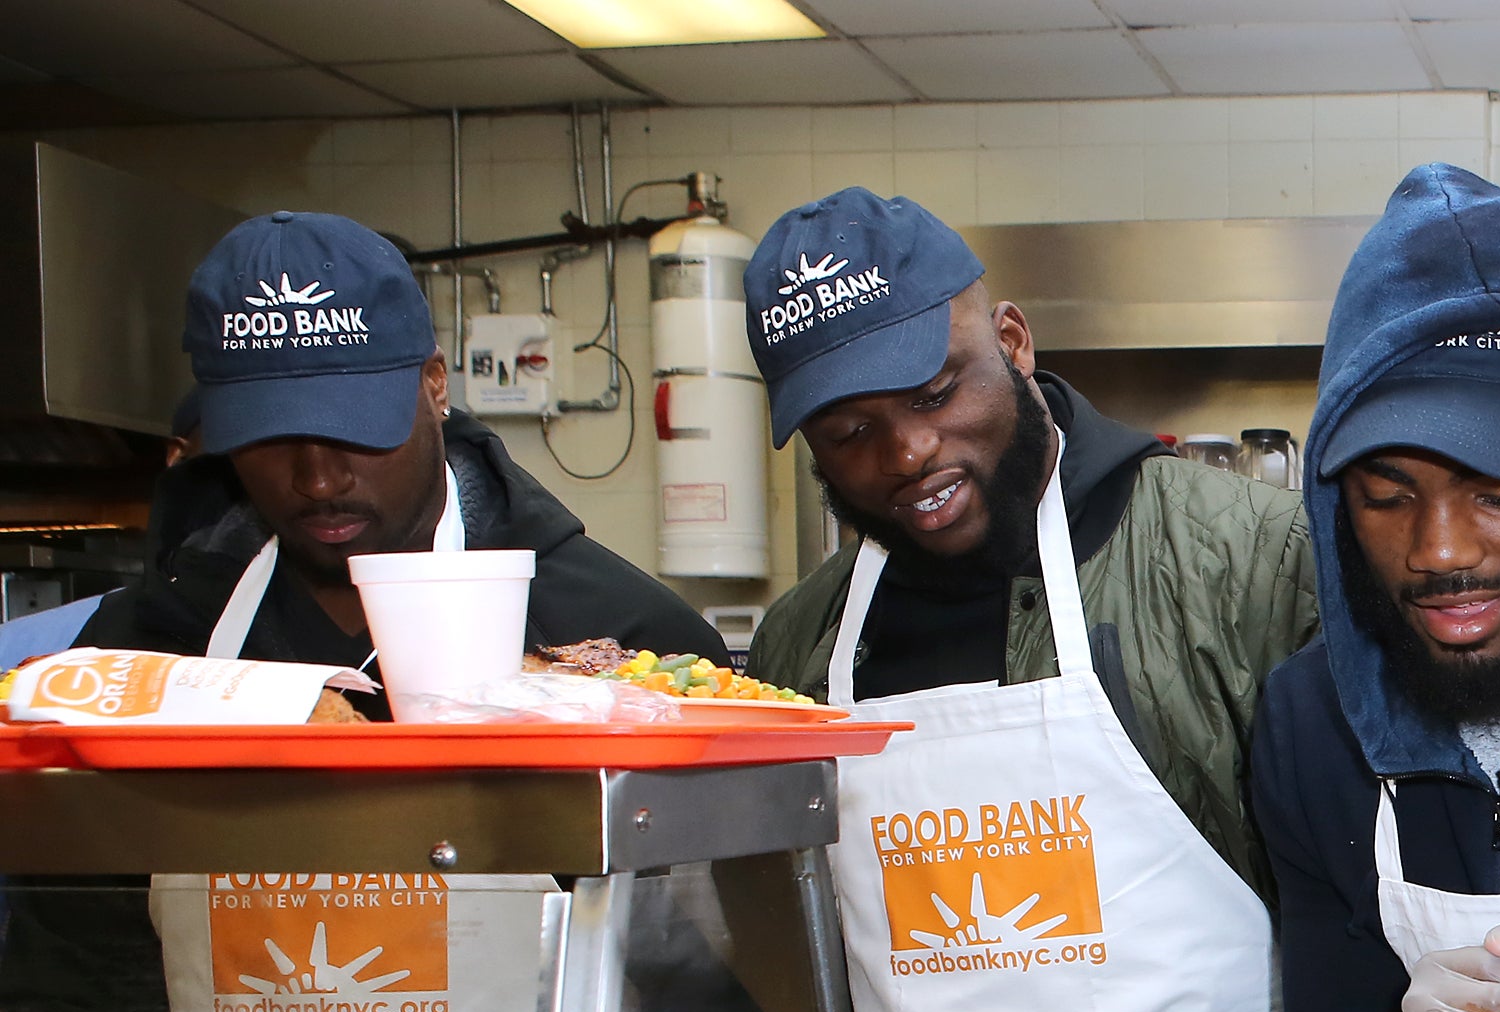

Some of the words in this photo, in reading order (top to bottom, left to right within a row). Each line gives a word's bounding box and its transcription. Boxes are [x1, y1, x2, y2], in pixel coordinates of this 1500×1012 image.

[761, 293, 814, 334] FOOD
[816, 266, 889, 309] BANK
[766, 330, 787, 346] FOR
[789, 316, 814, 336] NEW
[818, 300, 856, 322] YORK
[859, 285, 890, 305] CITY
[223, 312, 288, 337] FOOD
[294, 308, 369, 335] BANK
[223, 339, 247, 350] FOR
[252, 338, 284, 350] NEW
[290, 335, 333, 348] YORK
[337, 334, 369, 345] CITY
[1435, 336, 1469, 347] RK
[98, 654, 137, 714] ORAN
[870, 808, 969, 851] FOOD
[979, 794, 1091, 841] BANK
[881, 852, 915, 868] FOR
[922, 847, 964, 864] NEW
[974, 841, 1030, 858] YORK
[1041, 835, 1089, 853] CITY
[213, 895, 252, 909] FOR
[261, 894, 307, 908] NEW
[319, 892, 381, 908] YORK
[391, 891, 444, 906] CITY
[890, 942, 1107, 977] foodbanknyc.org
